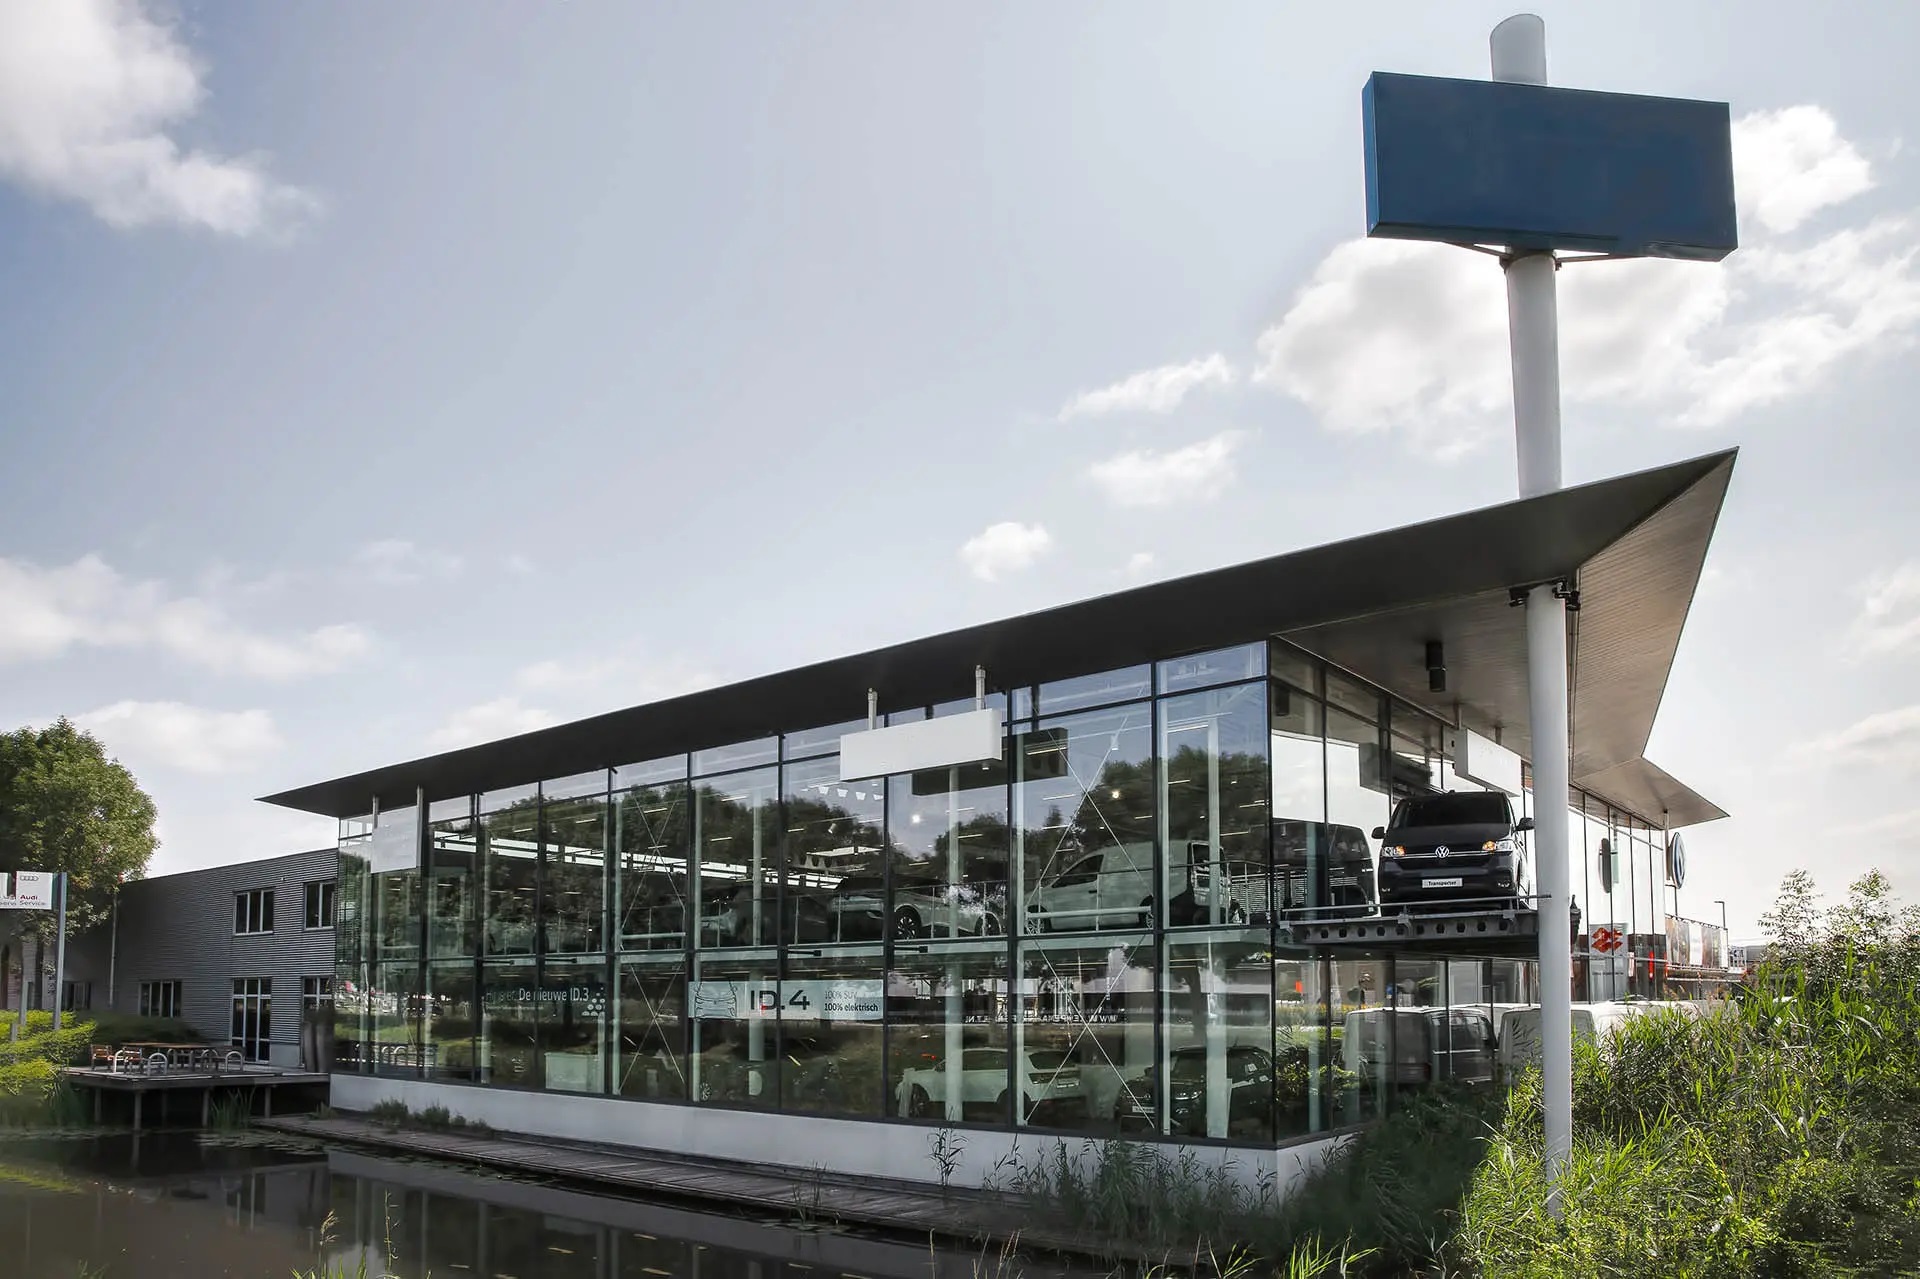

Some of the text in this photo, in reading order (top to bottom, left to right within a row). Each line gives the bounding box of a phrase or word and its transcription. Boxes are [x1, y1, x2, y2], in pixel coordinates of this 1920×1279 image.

[519, 987, 531, 1001] De
[570, 987, 589, 1002] ID.3
[750, 989, 811, 1011] ID.4
[824, 990, 843, 1000] 100%
[824, 1002, 879, 1012] 100% elektrisch
